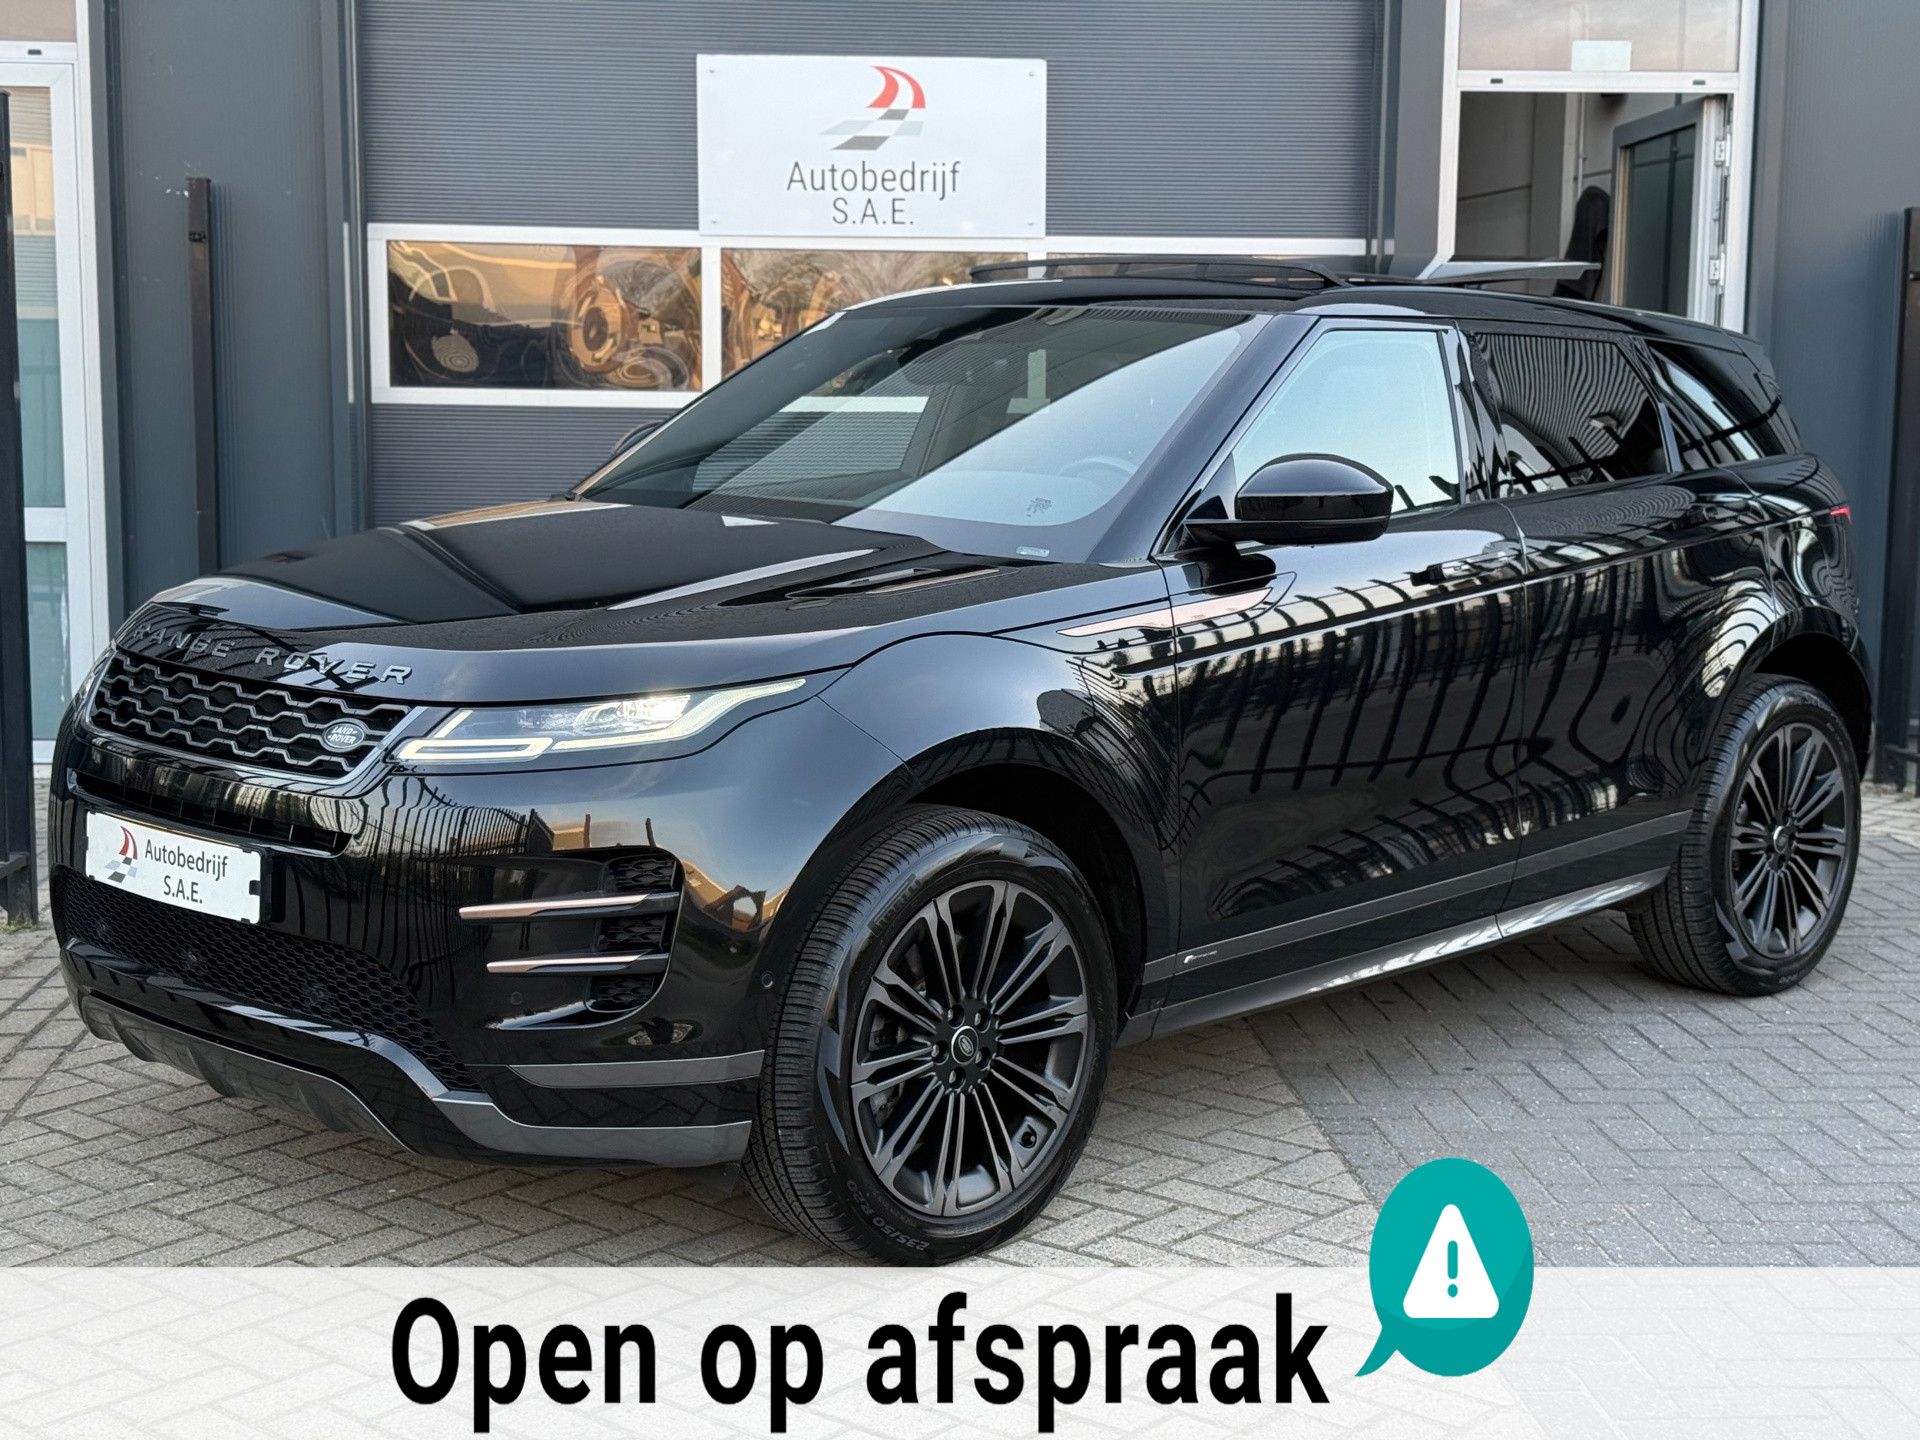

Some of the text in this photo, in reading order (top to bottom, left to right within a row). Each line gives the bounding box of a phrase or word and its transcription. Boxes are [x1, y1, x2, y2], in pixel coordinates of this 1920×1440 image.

[786, 160, 961, 200] Autobedrijf
[832, 197, 915, 225] S.A.E.
[131, 623, 413, 685] RANGE ROVER
[144, 839, 229, 881] Autobedrijf
[163, 875, 203, 904] S.A.E.
[872, 1216, 930, 1251] 235/50
